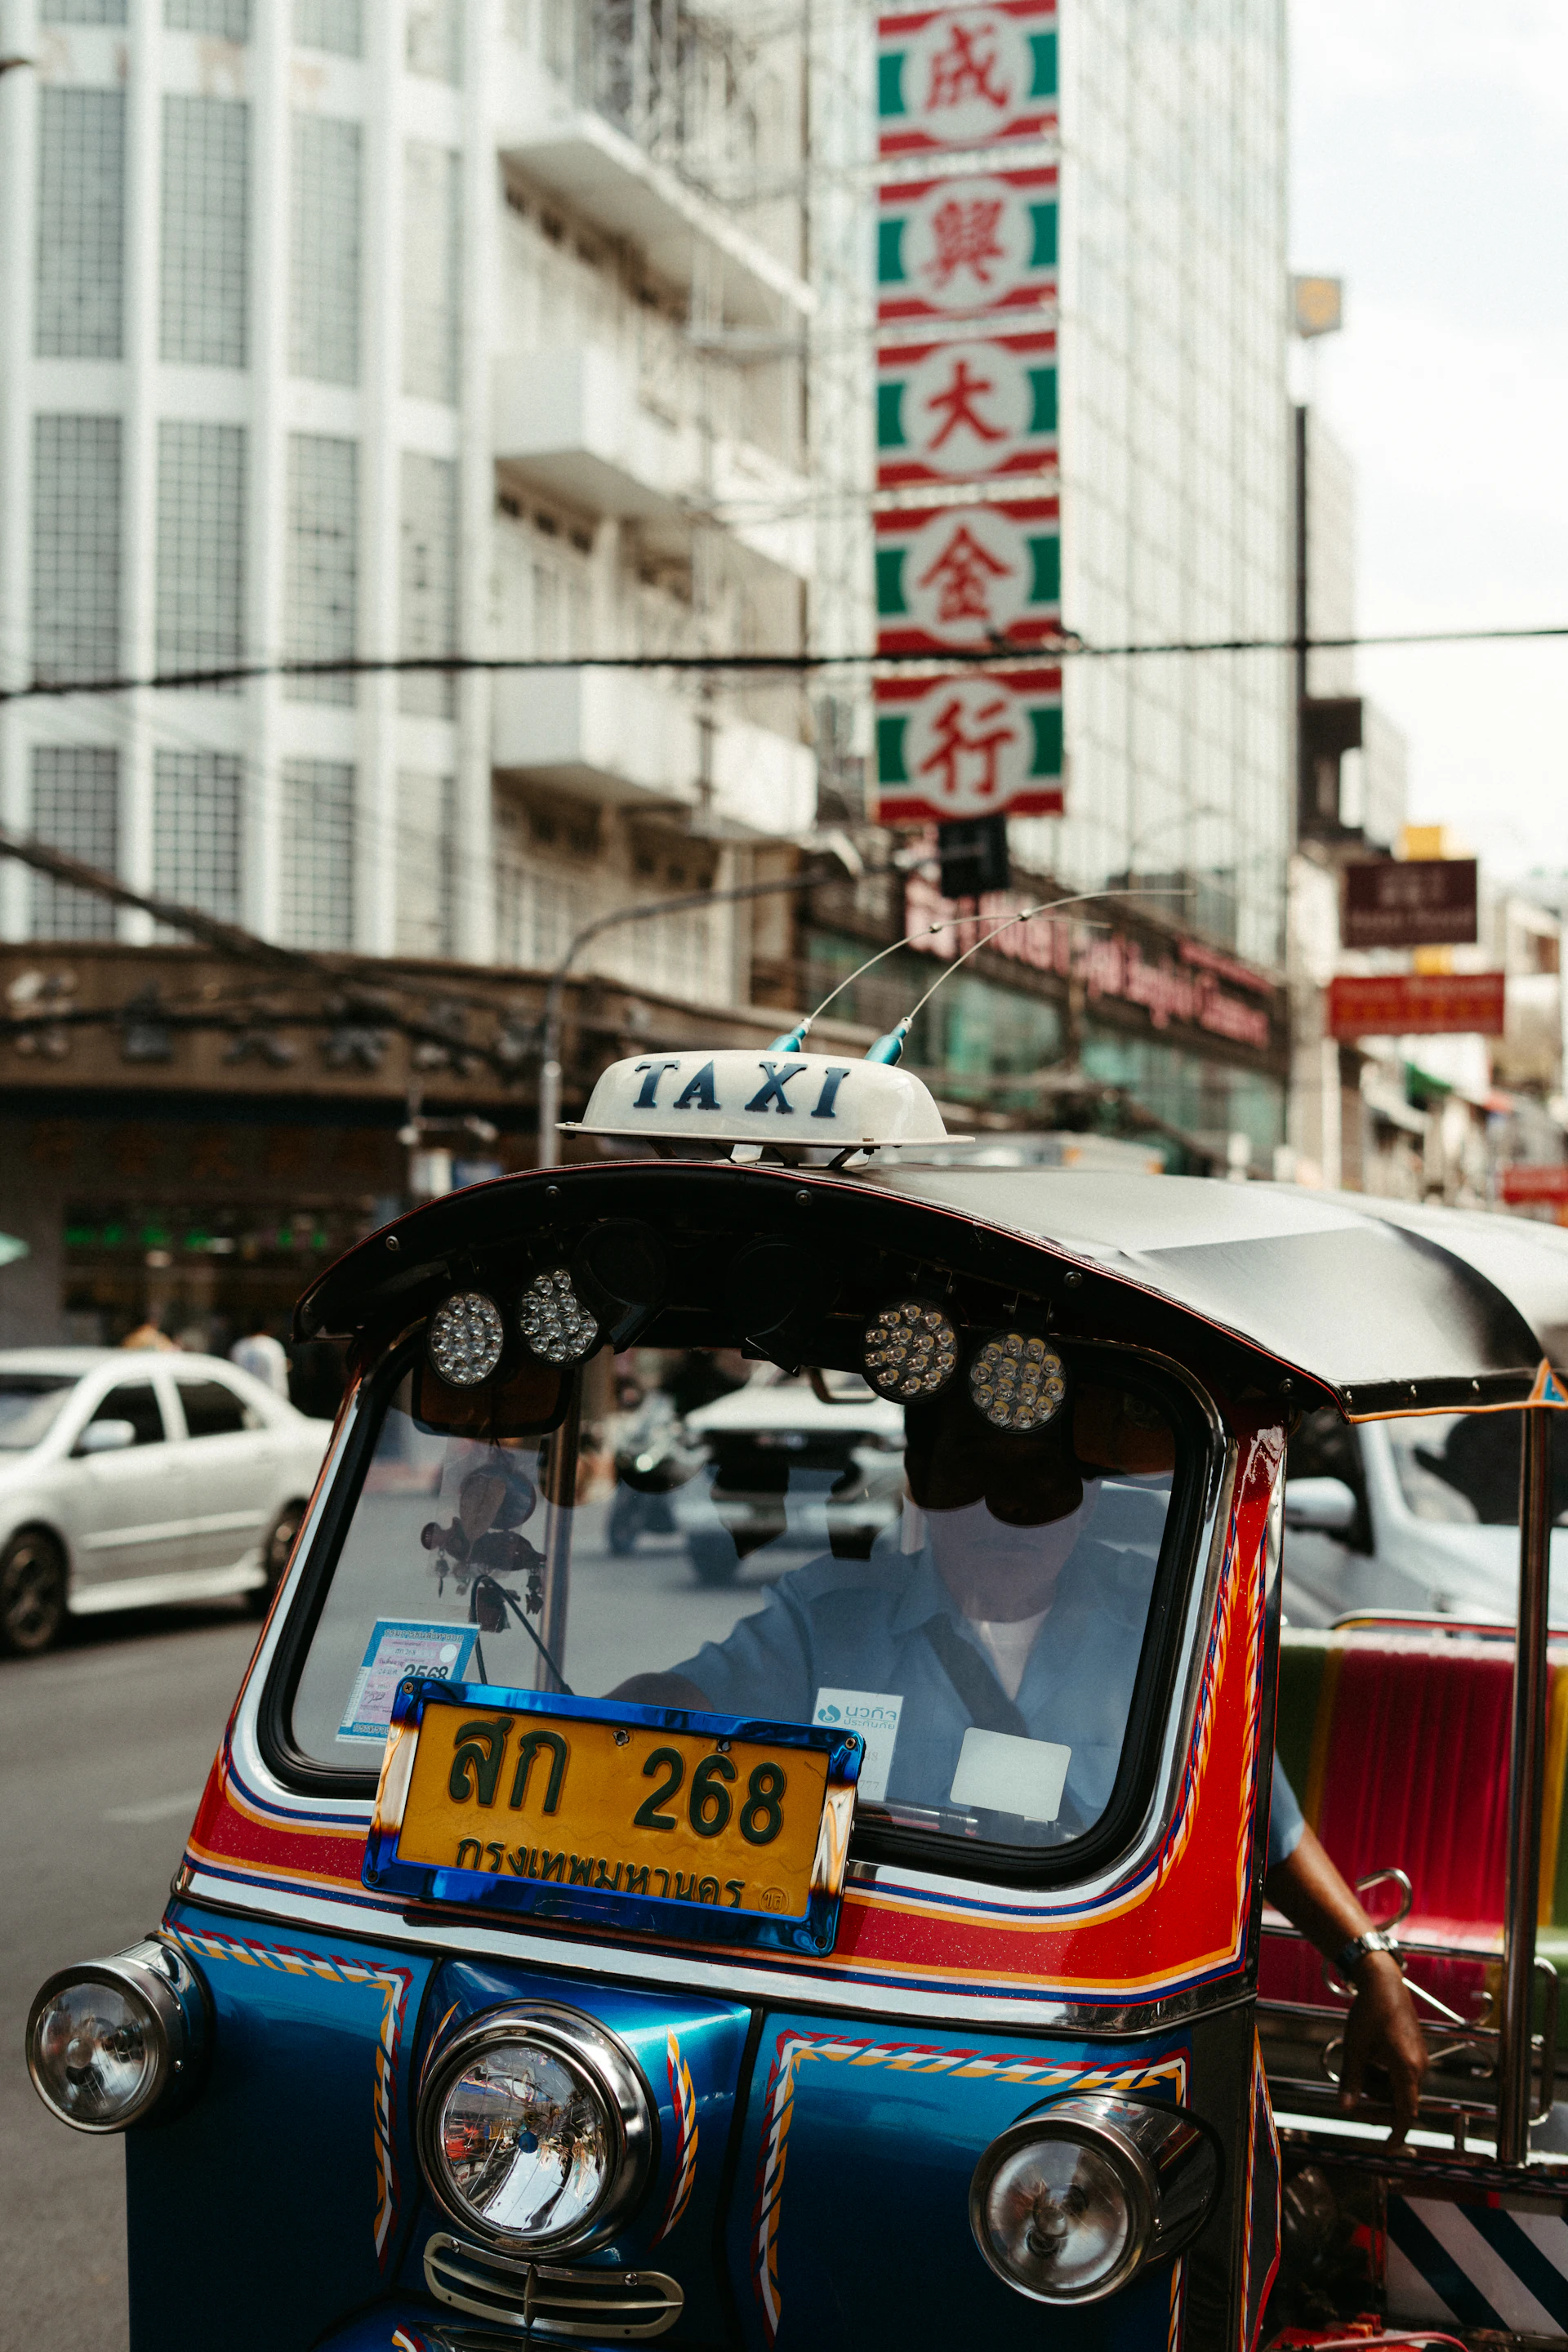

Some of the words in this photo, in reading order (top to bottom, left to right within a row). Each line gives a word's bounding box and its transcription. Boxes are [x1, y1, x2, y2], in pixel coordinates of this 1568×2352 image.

[632, 1059, 851, 1118] TAXI
[403, 1664, 448, 1680] 2568
[844, 1705, 898, 1721] นวกิจ
[843, 1717, 896, 1731] ประกันภัย
[448, 1716, 571, 1815] สก
[632, 1746, 786, 1846] 268
